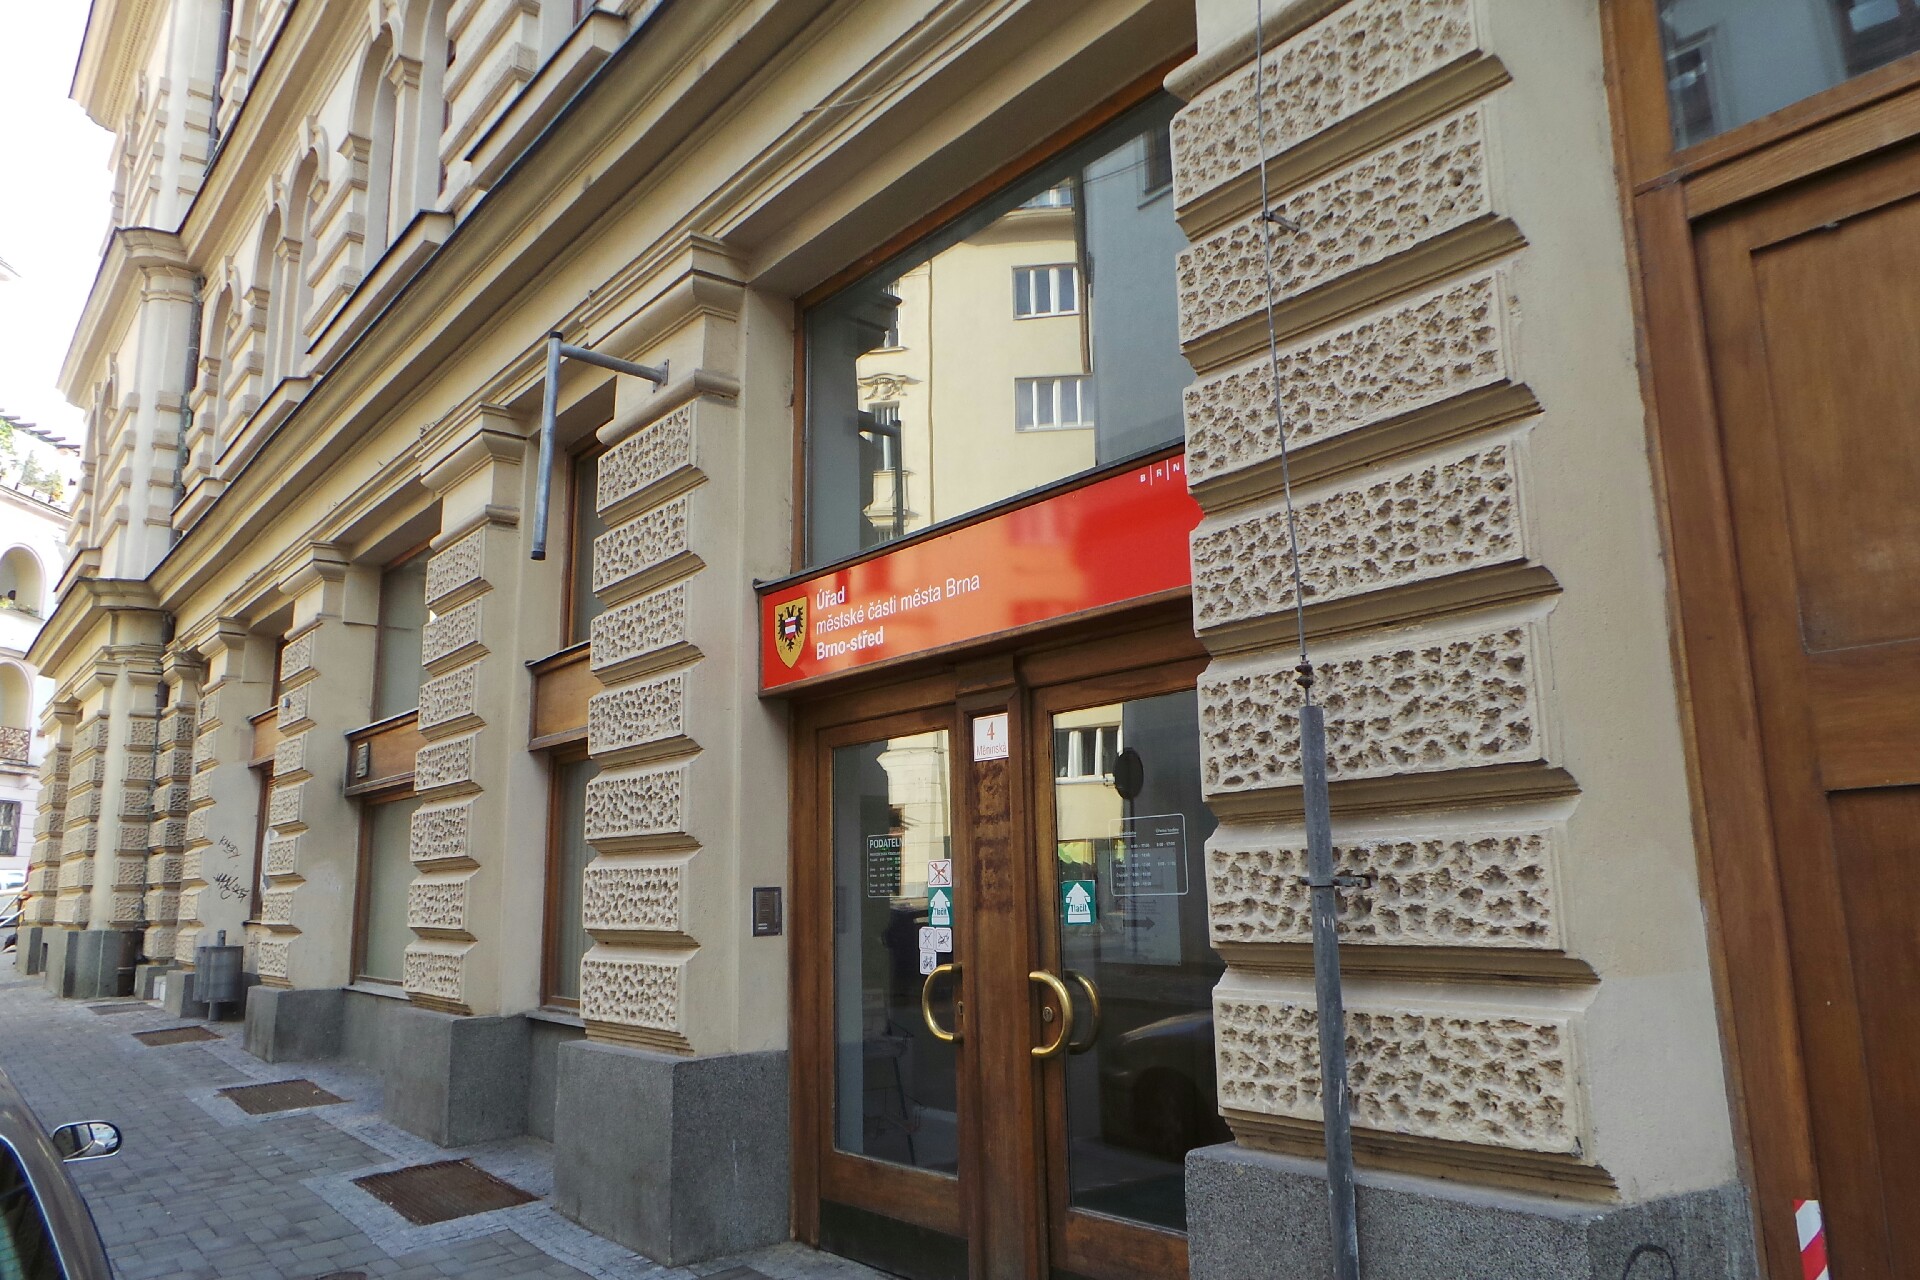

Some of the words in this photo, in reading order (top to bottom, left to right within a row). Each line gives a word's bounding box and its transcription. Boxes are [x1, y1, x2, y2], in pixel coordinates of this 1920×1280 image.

[816, 586, 845, 610] Úřad
[816, 606, 864, 634] městské
[868, 595, 897, 620] části
[900, 585, 941, 612] města
[946, 574, 980, 598] Brna
[816, 625, 884, 661] Brno-střed
[987, 721, 995, 740] 4
[933, 907, 947, 916] Tlačit
[1070, 903, 1088, 913] Tlačit
